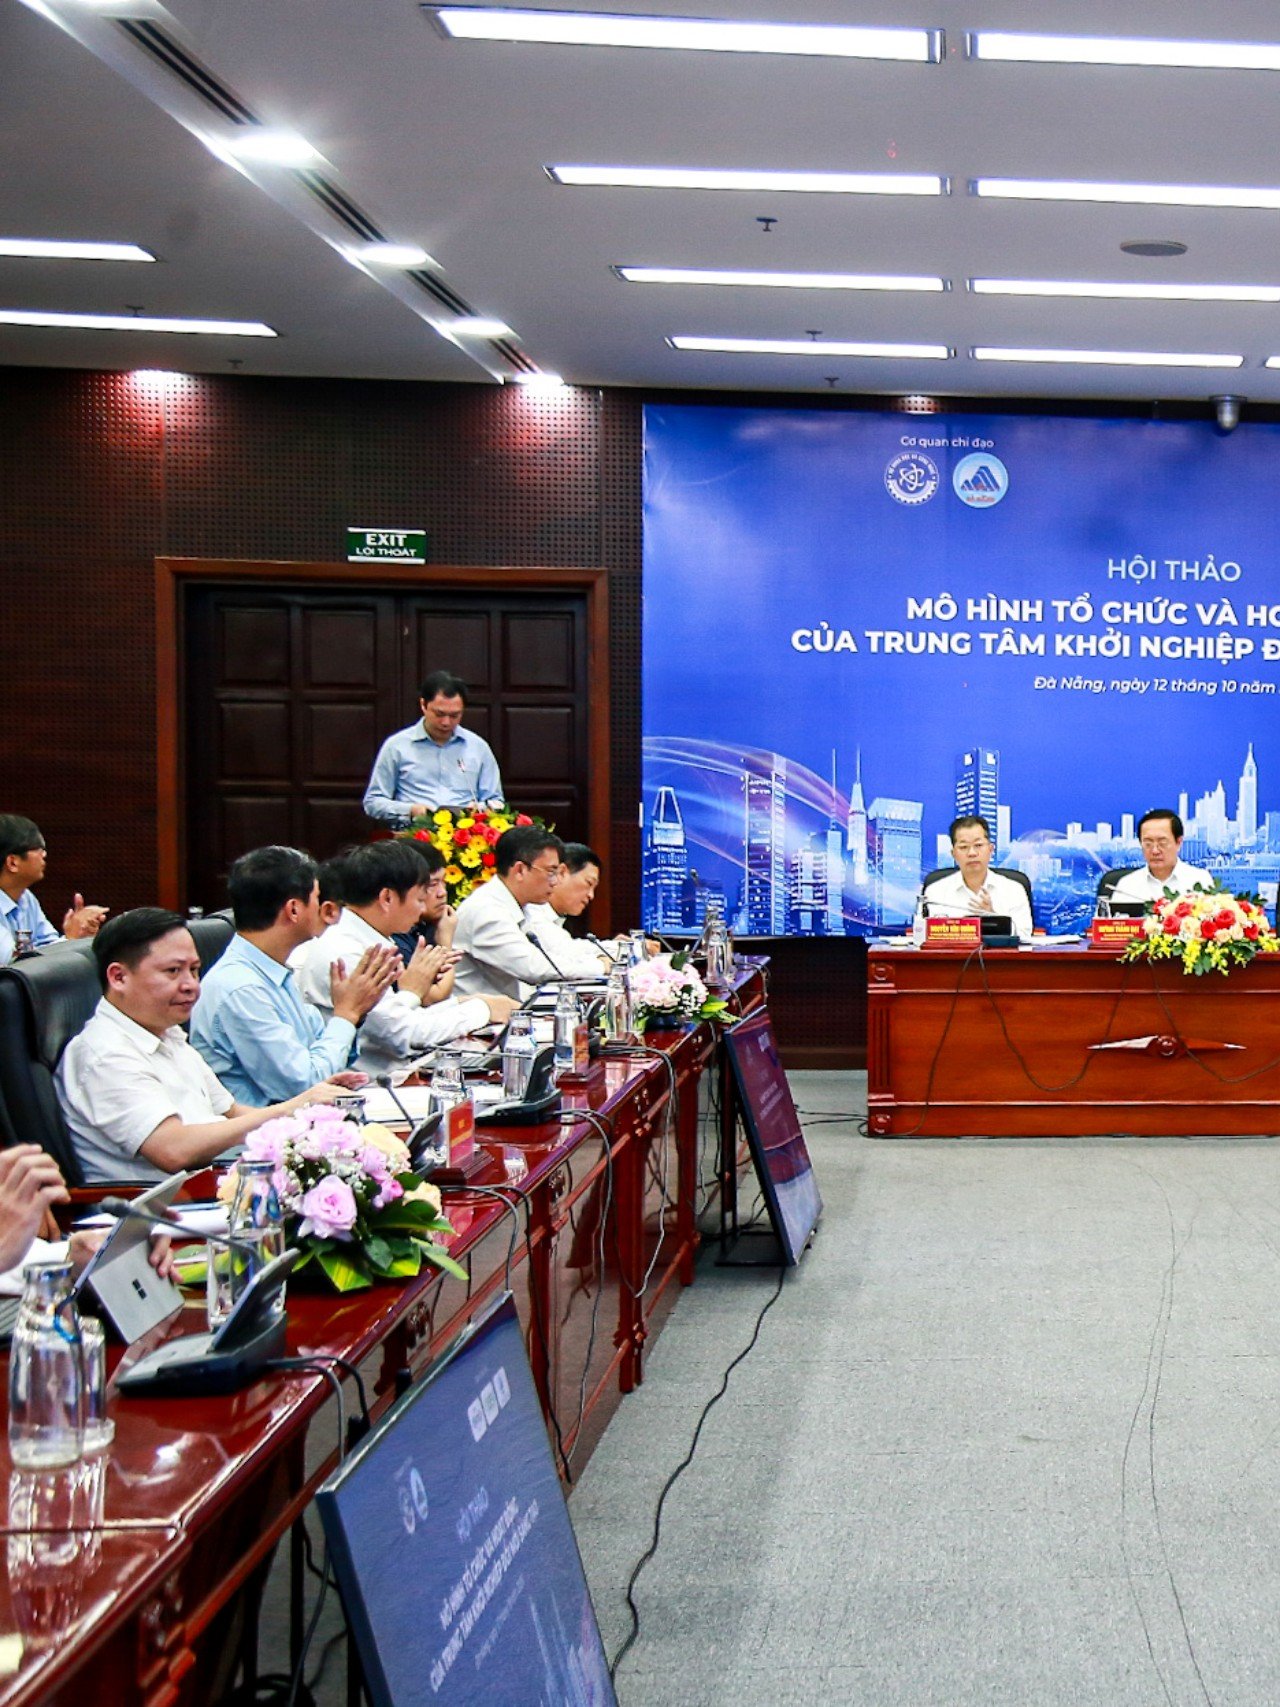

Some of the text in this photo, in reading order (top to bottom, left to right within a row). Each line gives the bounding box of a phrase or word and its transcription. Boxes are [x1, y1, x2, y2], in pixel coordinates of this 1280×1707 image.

[901, 436, 917, 447] Cơ
[919, 437, 949, 448] quan
[972, 437, 995, 450] đạo
[366, 533, 407, 547] EXIT
[1107, 554, 1242, 585] HỘI THẢO
[906, 592, 959, 622] MÔ
[966, 593, 1044, 623] HÌNH
[1052, 592, 1094, 624] TỔ
[1101, 596, 1188, 625] CHỨC
[1195, 597, 1239, 627] VÀ
[790, 621, 858, 653] CỦA
[865, 630, 972, 655] TRUNG
[978, 627, 1046, 656] TÂM
[1054, 627, 1130, 658] KHỞI
[1140, 631, 1255, 666] NGHIỆP
[1033, 676, 1057, 690] Đà
[1109, 678, 1149, 694] ngày
[1153, 679, 1168, 691] 12
[1171, 678, 1219, 695] tháng
[1221, 679, 1238, 693] 10
[1240, 679, 1277, 694] năm
